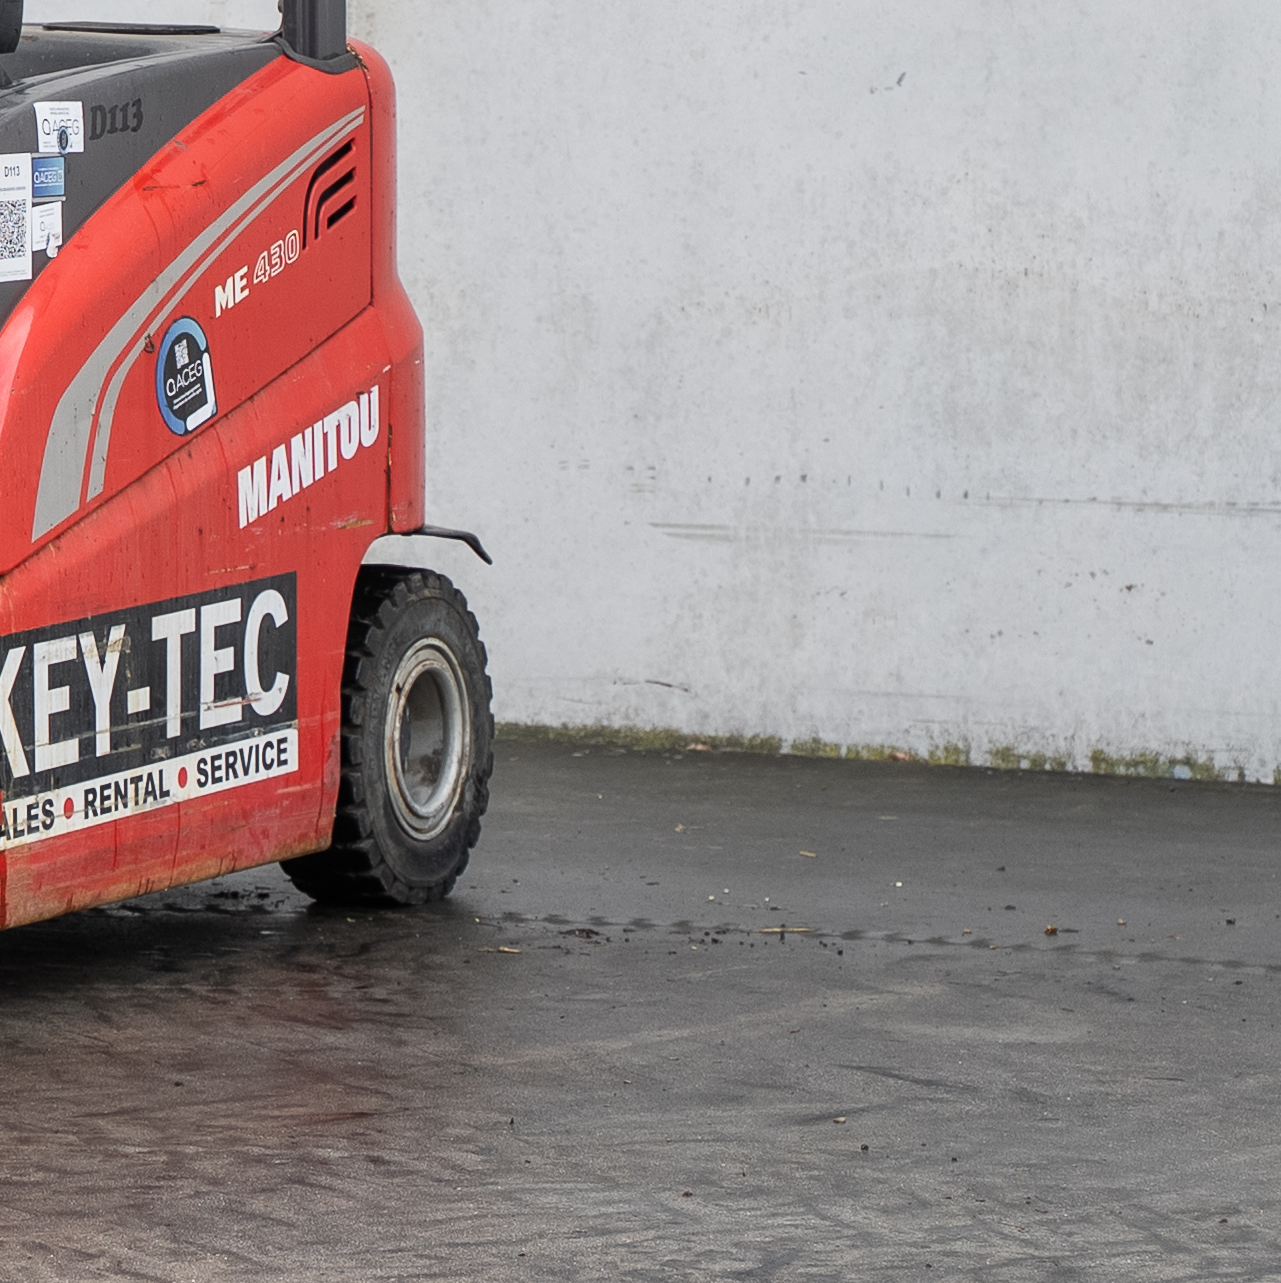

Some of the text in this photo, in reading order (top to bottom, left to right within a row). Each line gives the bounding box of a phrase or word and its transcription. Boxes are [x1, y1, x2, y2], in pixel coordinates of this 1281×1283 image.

[89, 98, 143, 141] D113
[4, 165, 21, 178] D113
[214, 229, 300, 319] ME 430
[237, 384, 380, 530] MANITOU
[83, 769, 171, 820] RENTAL
[196, 737, 289, 788] SERVICE
